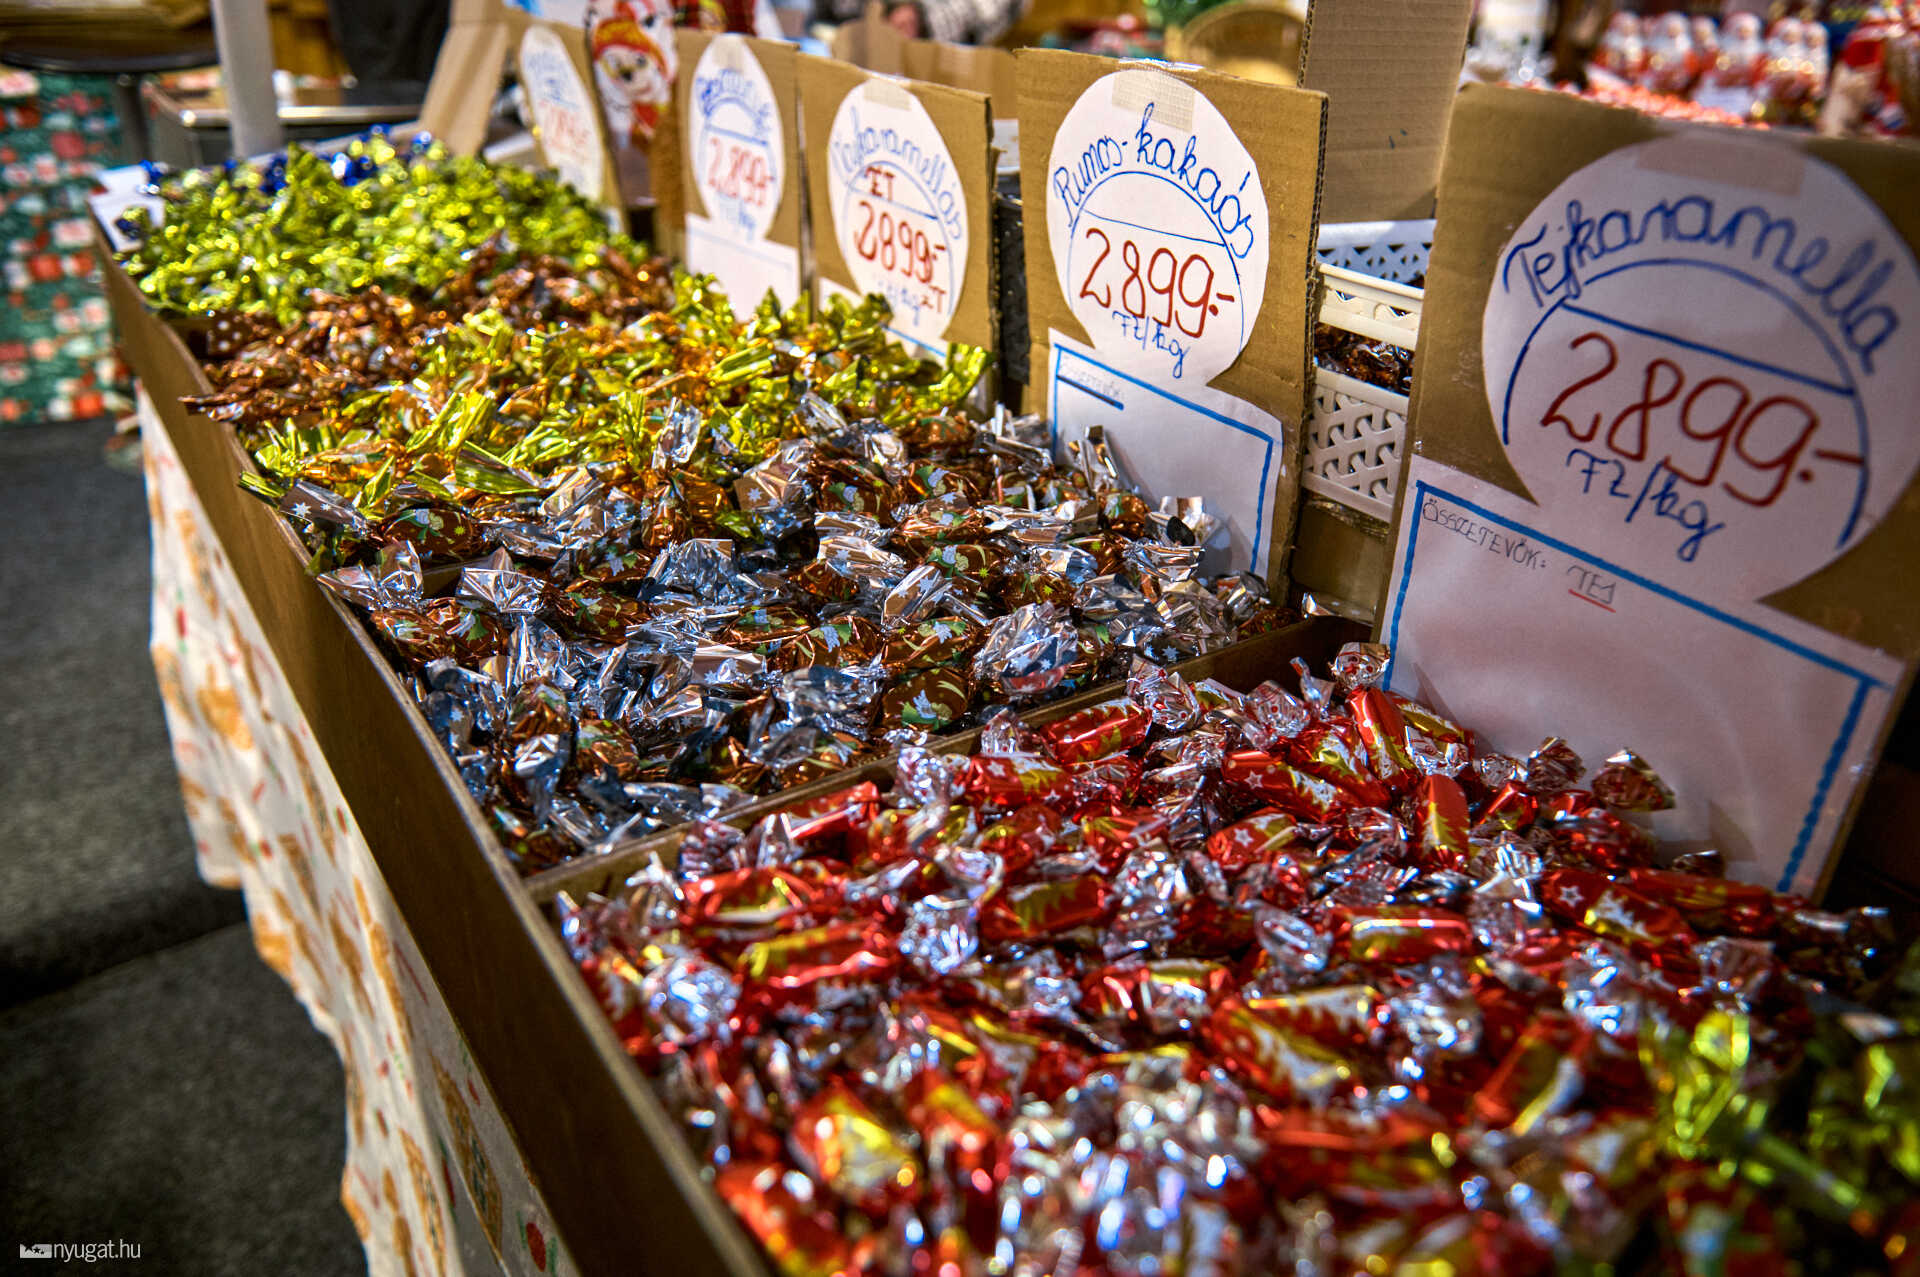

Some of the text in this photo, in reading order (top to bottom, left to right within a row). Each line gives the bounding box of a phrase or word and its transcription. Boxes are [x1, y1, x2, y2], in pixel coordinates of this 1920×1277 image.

[1054, 102, 1254, 259] Rumos-kakaós
[1080, 228, 1235, 338] 2899.-
[1503, 196, 1899, 375] Tejkaramella
[1112, 311, 1190, 379] Ft/kg
[1541, 332, 1866, 507] 2899.-
[1567, 448, 1725, 562] Ft/kg
[1566, 565, 1617, 604] TEJ
